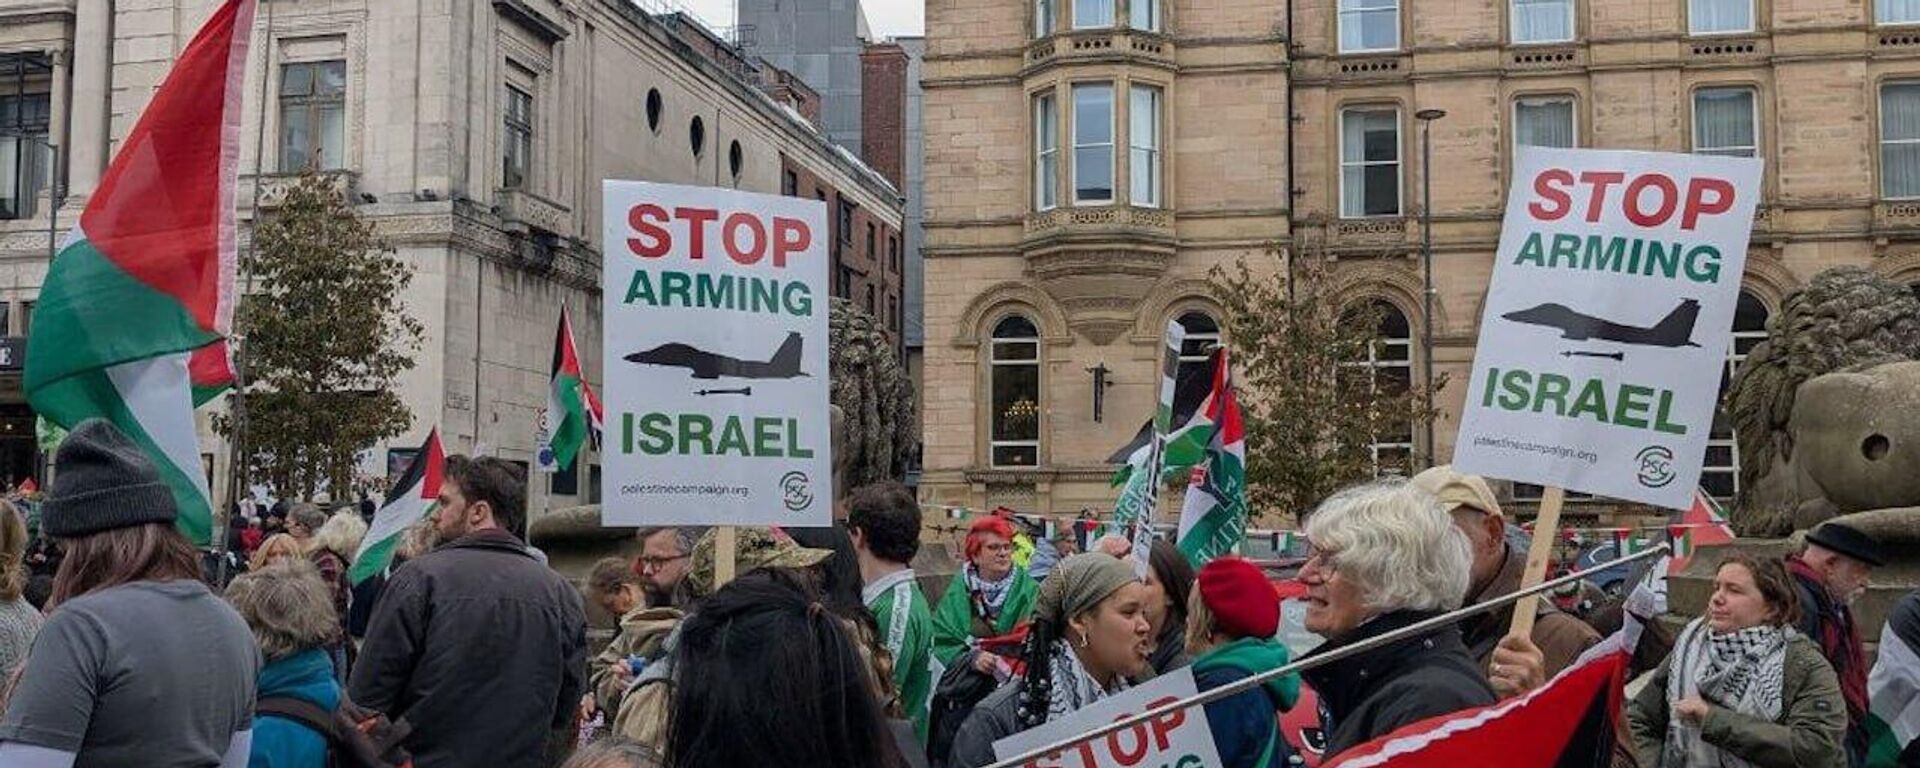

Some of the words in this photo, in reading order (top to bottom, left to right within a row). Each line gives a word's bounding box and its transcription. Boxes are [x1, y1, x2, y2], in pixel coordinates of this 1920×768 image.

[1528, 168, 1736, 231] STOP
[626, 203, 812, 268] STOP
[1513, 232, 1723, 284] ARMING
[623, 269, 813, 317] ARMING
[1481, 367, 1688, 436] ISRAEL
[621, 412, 814, 459] ISRAEL
[1022, 696, 1185, 768] TOP
